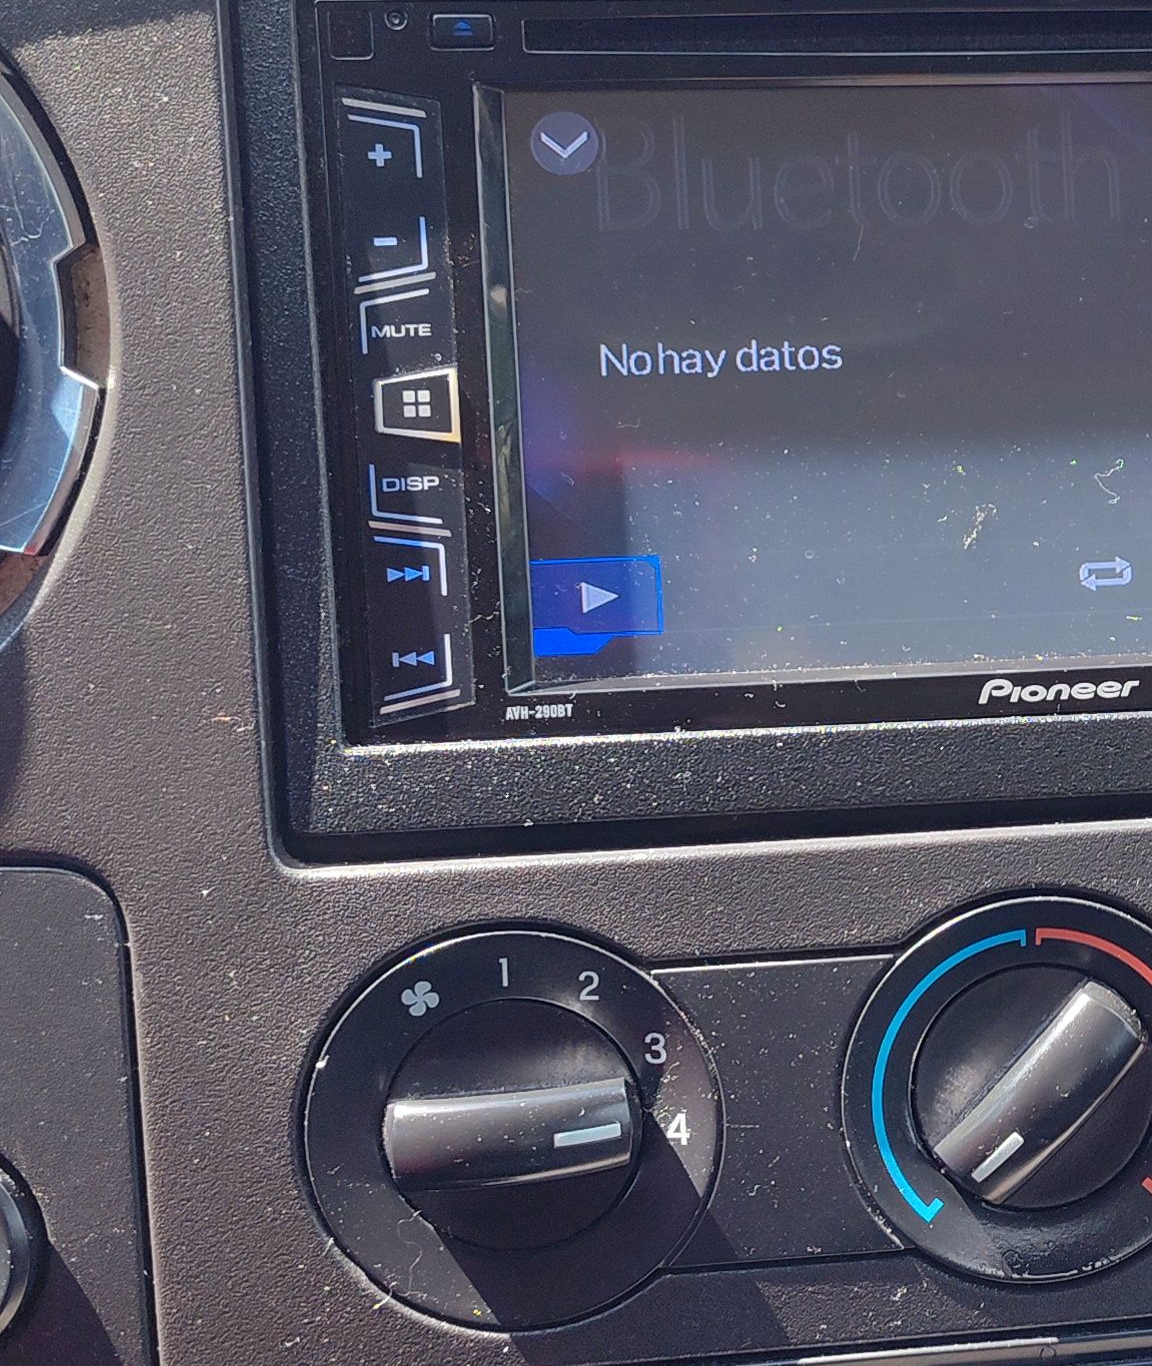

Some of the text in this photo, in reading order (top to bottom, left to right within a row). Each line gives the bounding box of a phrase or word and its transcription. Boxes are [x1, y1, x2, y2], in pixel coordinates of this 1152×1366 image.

[596, 111, 1121, 230] Bluetooth
[371, 323, 432, 338] MUTE
[735, 339, 843, 372] datos
[382, 476, 440, 492] DISP
[978, 678, 1140, 705] Pioneer
[498, 957, 511, 987] 1
[577, 971, 601, 1001] 2
[643, 1033, 668, 1064] 3
[666, 1113, 691, 1145] 4
